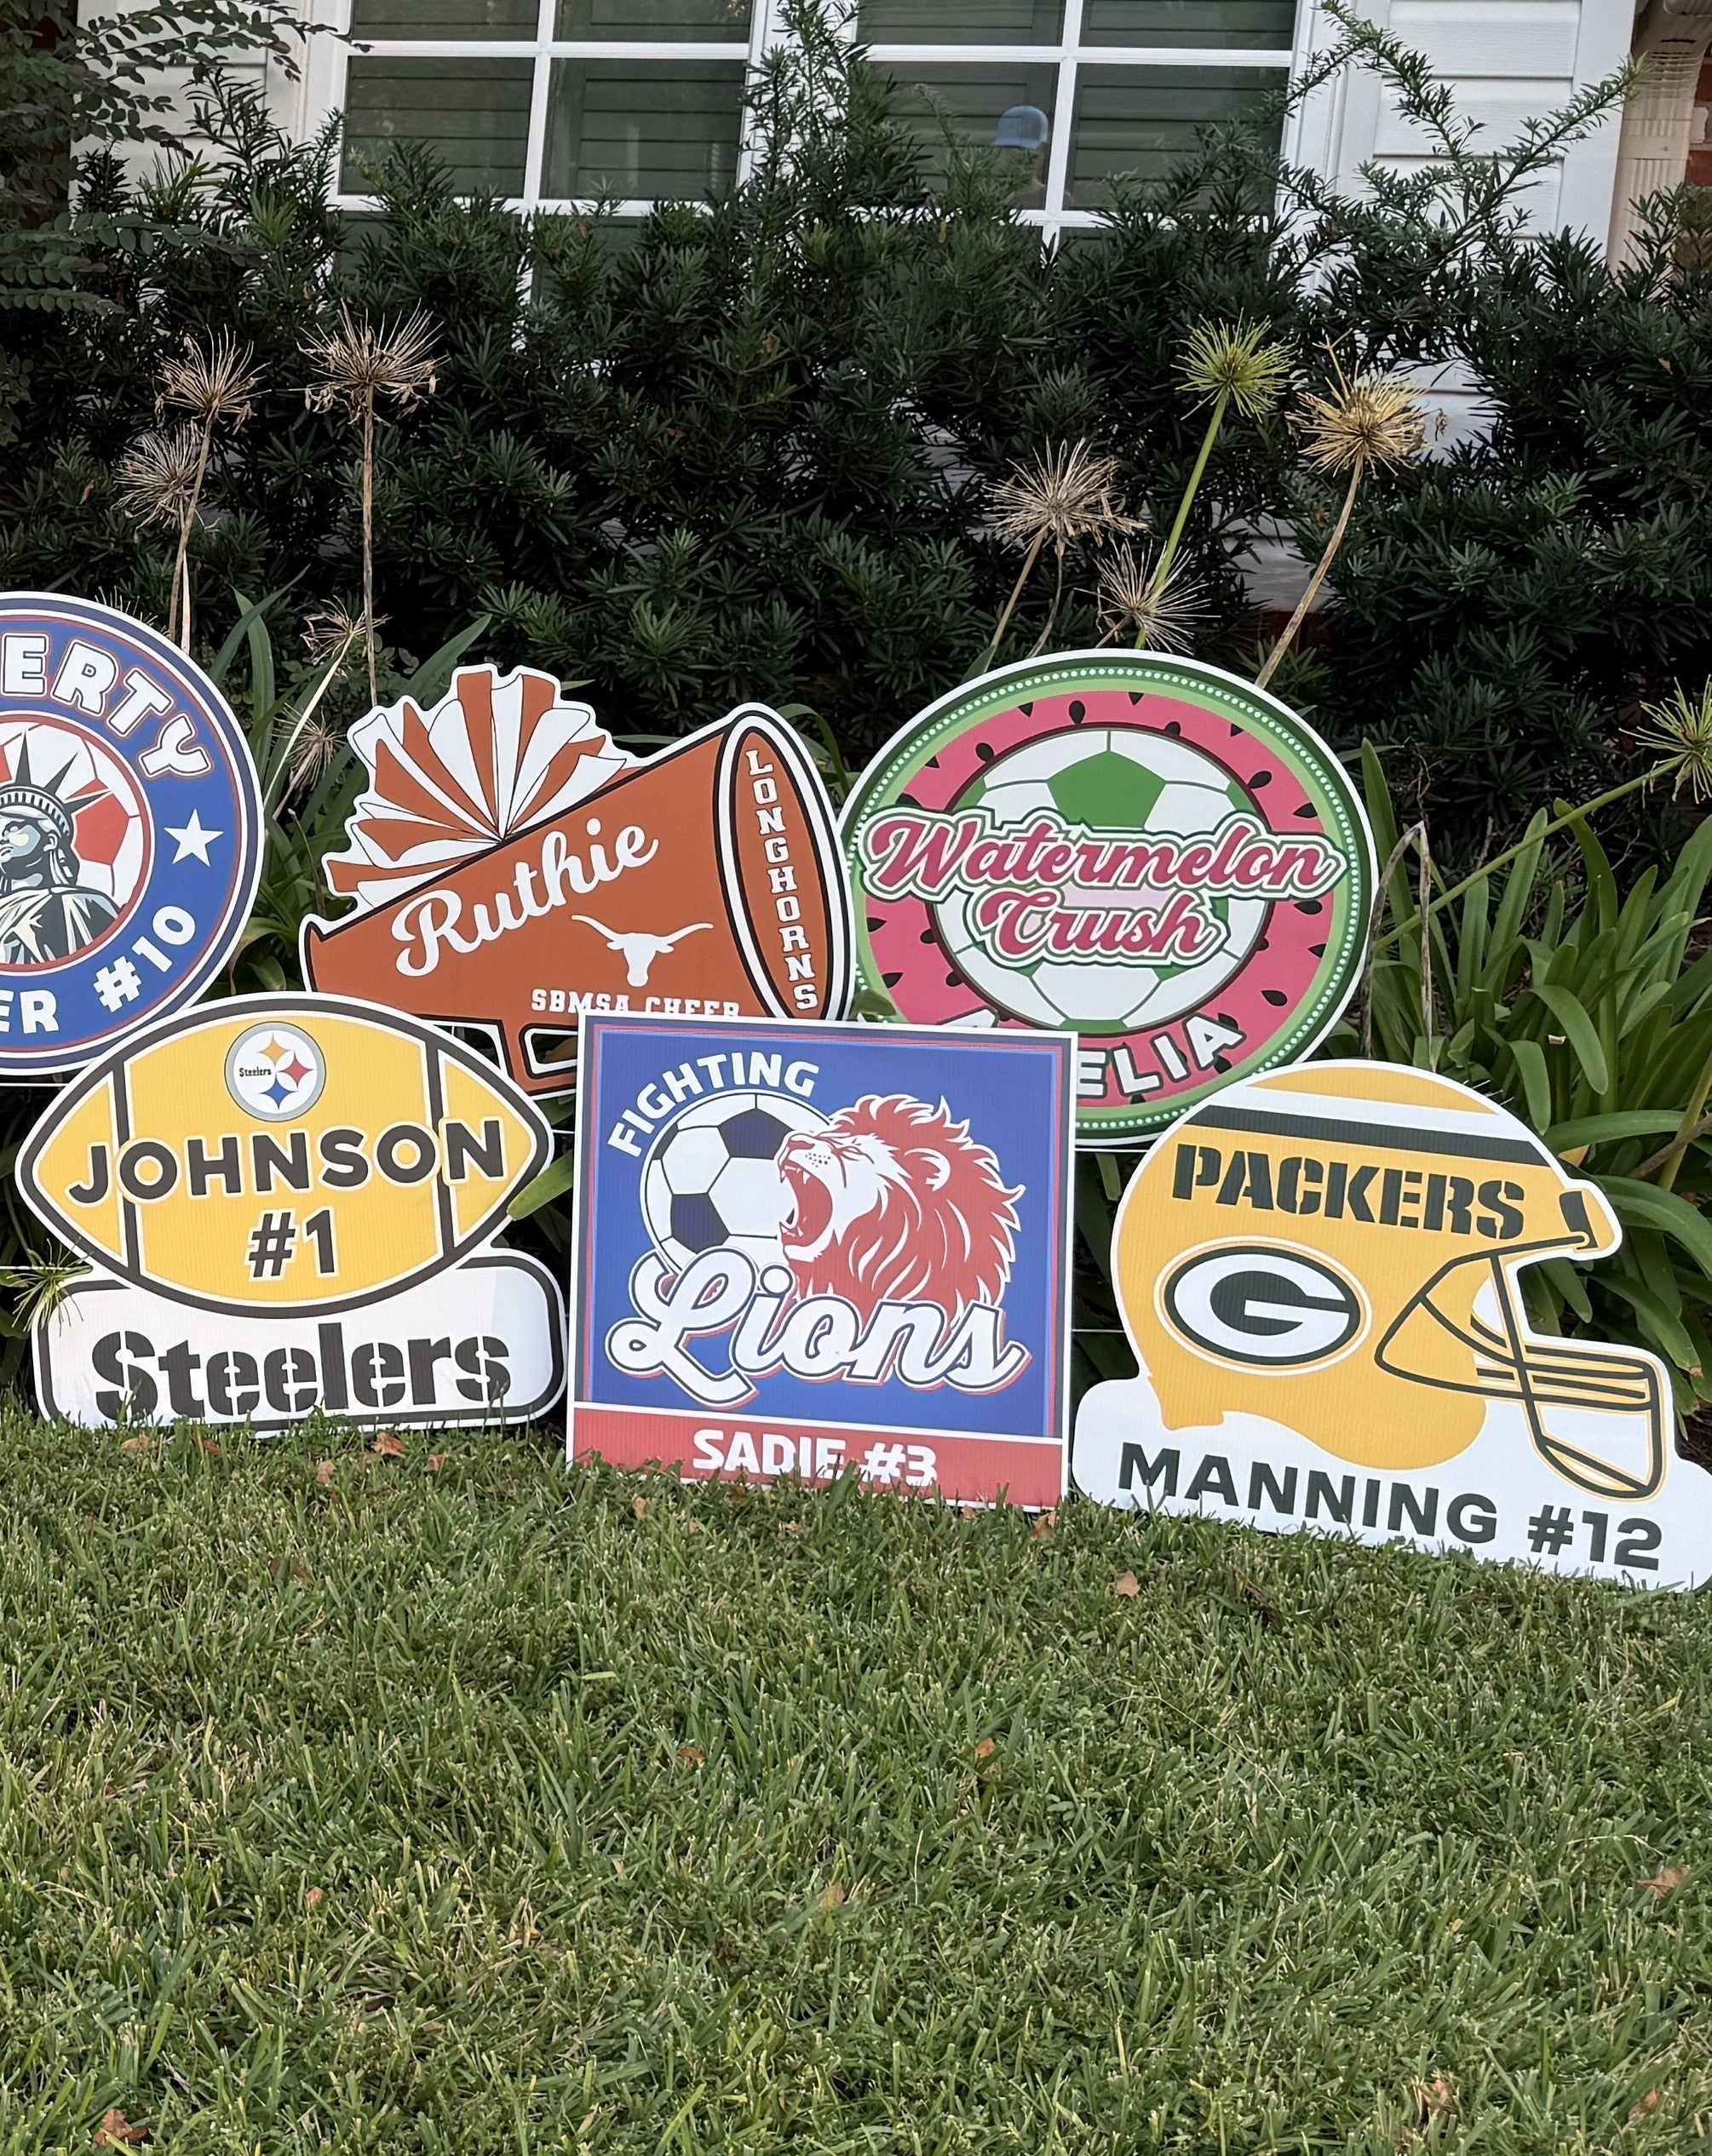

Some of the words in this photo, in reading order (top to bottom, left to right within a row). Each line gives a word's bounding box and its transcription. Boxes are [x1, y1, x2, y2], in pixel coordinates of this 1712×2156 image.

[392, 818, 659, 976] Ruthie
[745, 749, 818, 1010] LONGHORNS
[864, 815, 1334, 892] Watermelon
[93, 905, 196, 1012] #10
[976, 887, 1221, 960] Crush
[531, 989, 629, 1013] SBMSA
[239, 1066, 272, 1077] Steelers
[607, 1051, 819, 1157] FIGHTING
[68, 1121, 505, 1203] JOHNSON
[1172, 1144, 1525, 1240] PACKERS
[247, 1209, 336, 1278] #1
[92, 1323, 511, 1422] Steelers
[606, 1247, 1029, 1405] Lions
[692, 1429, 846, 1480] SADIE
[860, 1442, 937, 1487] #3
[1118, 1442, 1497, 1544] MANNING
[1528, 1505, 1663, 1571] #12
